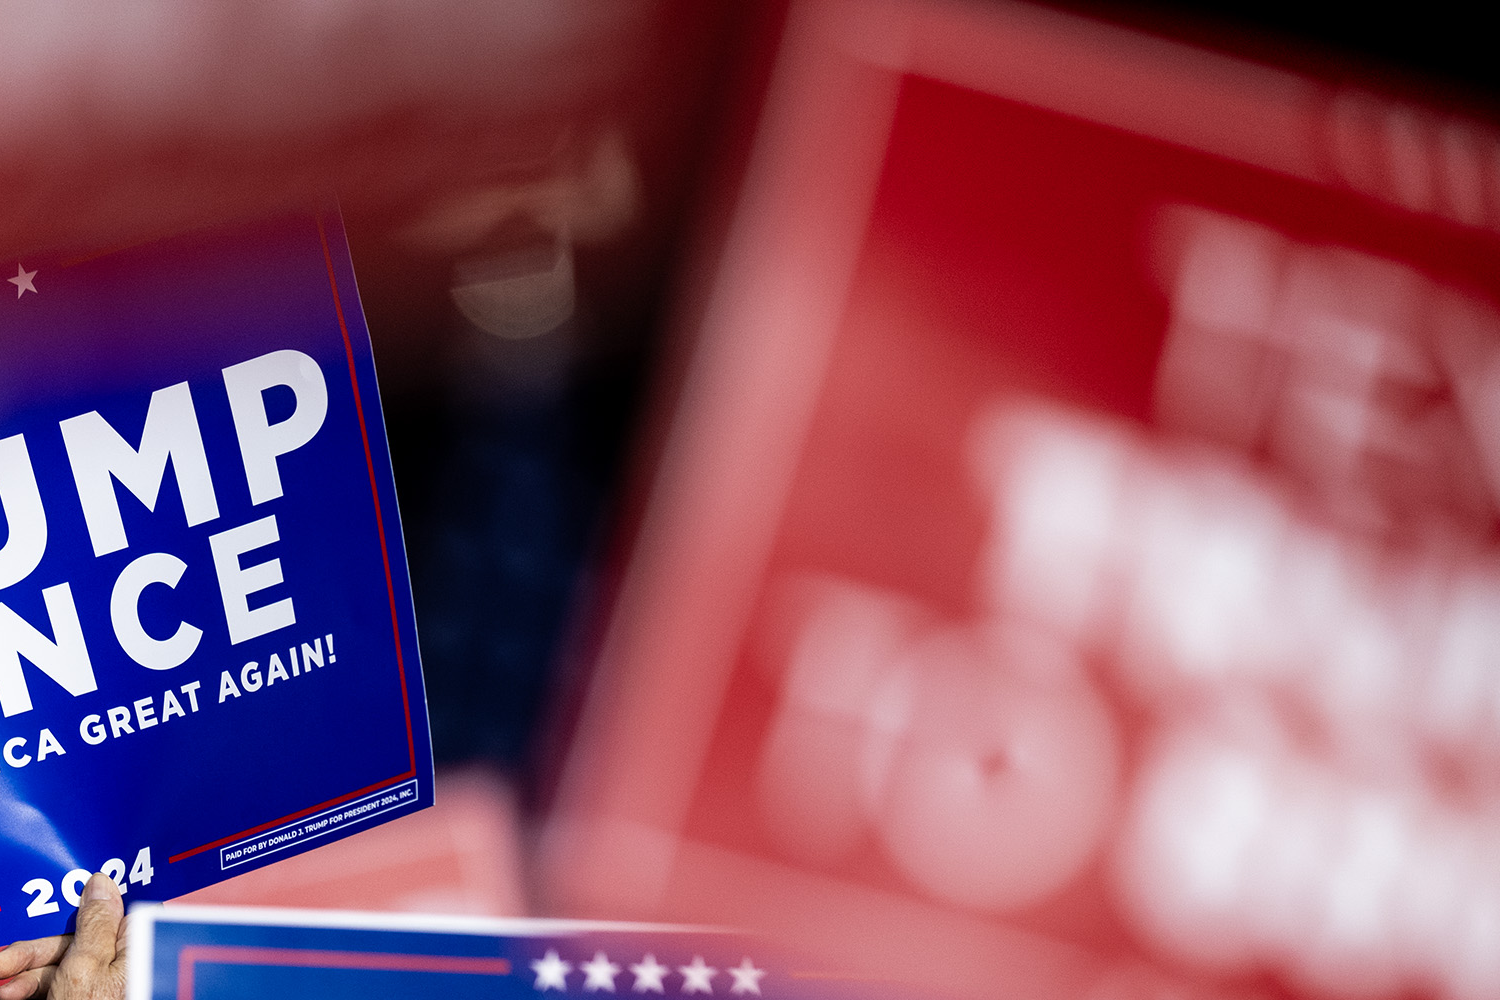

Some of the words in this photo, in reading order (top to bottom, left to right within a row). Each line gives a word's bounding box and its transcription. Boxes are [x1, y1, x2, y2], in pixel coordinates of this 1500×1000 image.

[78, 679, 204, 746] GREAT
[216, 632, 338, 704] AGAIN!
[225, 850, 242, 862] PAID
[243, 845, 257, 856] FOR
[258, 840, 267, 850] BY
[268, 830, 297, 847] DONALD
[298, 828, 304, 837] J.
[305, 819, 329, 834] TRUMP
[329, 814, 343, 825] FOR
[344, 800, 380, 819] PRESIDENT
[380, 793, 399, 806] 2024,
[399, 788, 414, 799] INC.
[20, 845, 155, 919] 2024
